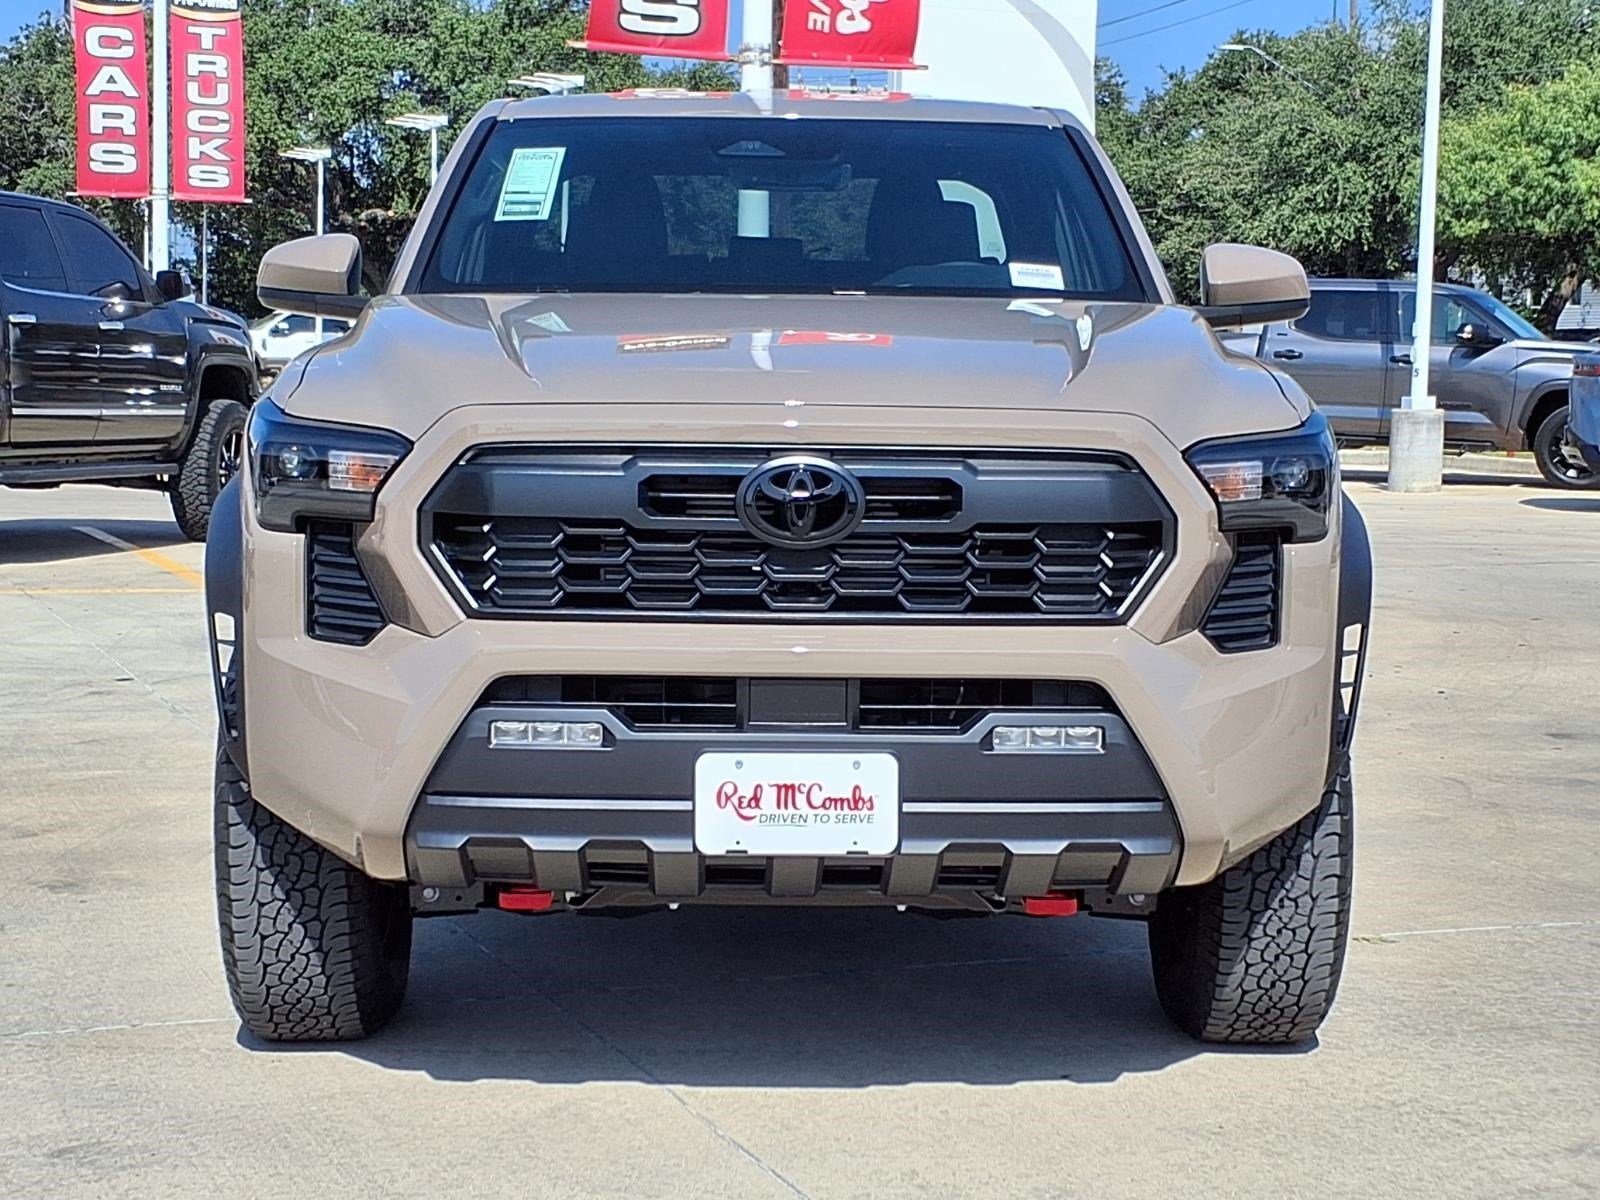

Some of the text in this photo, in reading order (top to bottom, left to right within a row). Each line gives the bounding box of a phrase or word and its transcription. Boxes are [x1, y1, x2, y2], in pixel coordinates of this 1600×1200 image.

[84, 26, 140, 174] CARS
[186, 25, 235, 189] TRUCKS
[716, 780, 875, 822] Red McCombs
[758, 813, 875, 824] DRIVEN TO SERVE
